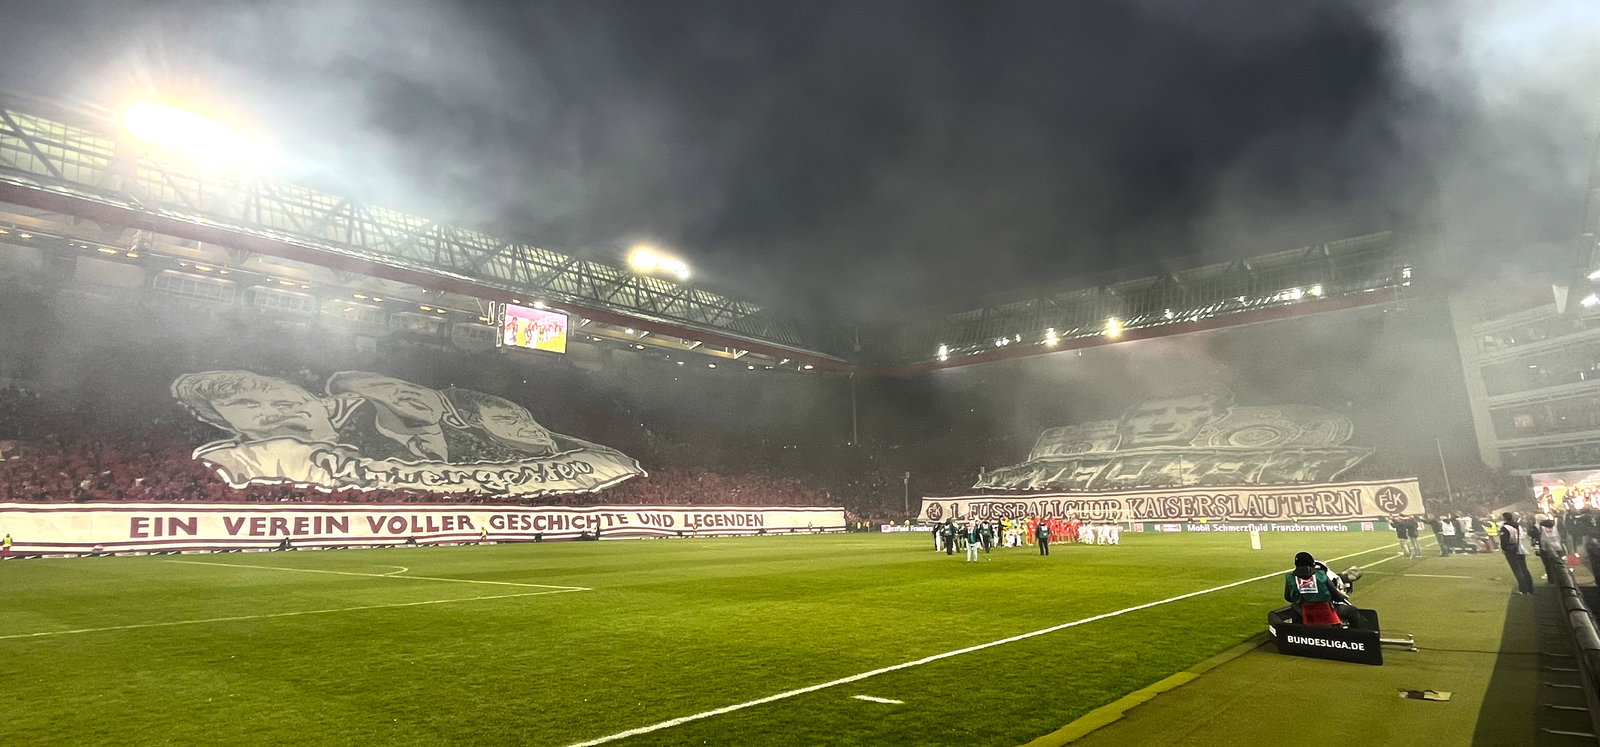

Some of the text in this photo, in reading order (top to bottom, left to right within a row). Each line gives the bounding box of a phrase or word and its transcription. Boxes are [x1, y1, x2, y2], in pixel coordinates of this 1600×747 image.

[968, 499, 1123, 522] FUSSBALLCLUB
[1126, 488, 1363, 521] KAISERSLAUTERN
[130, 513, 765, 538] EIN VEREIN VOLLER GESCHICHTE UND LEGENDEN
[1187, 523, 1210, 532] Mobil
[1213, 523, 1269, 533] Schmerzfluid
[1271, 523, 1348, 532] Franzbranntwein
[1287, 635, 1365, 651] BUNDESLIGA.DE
